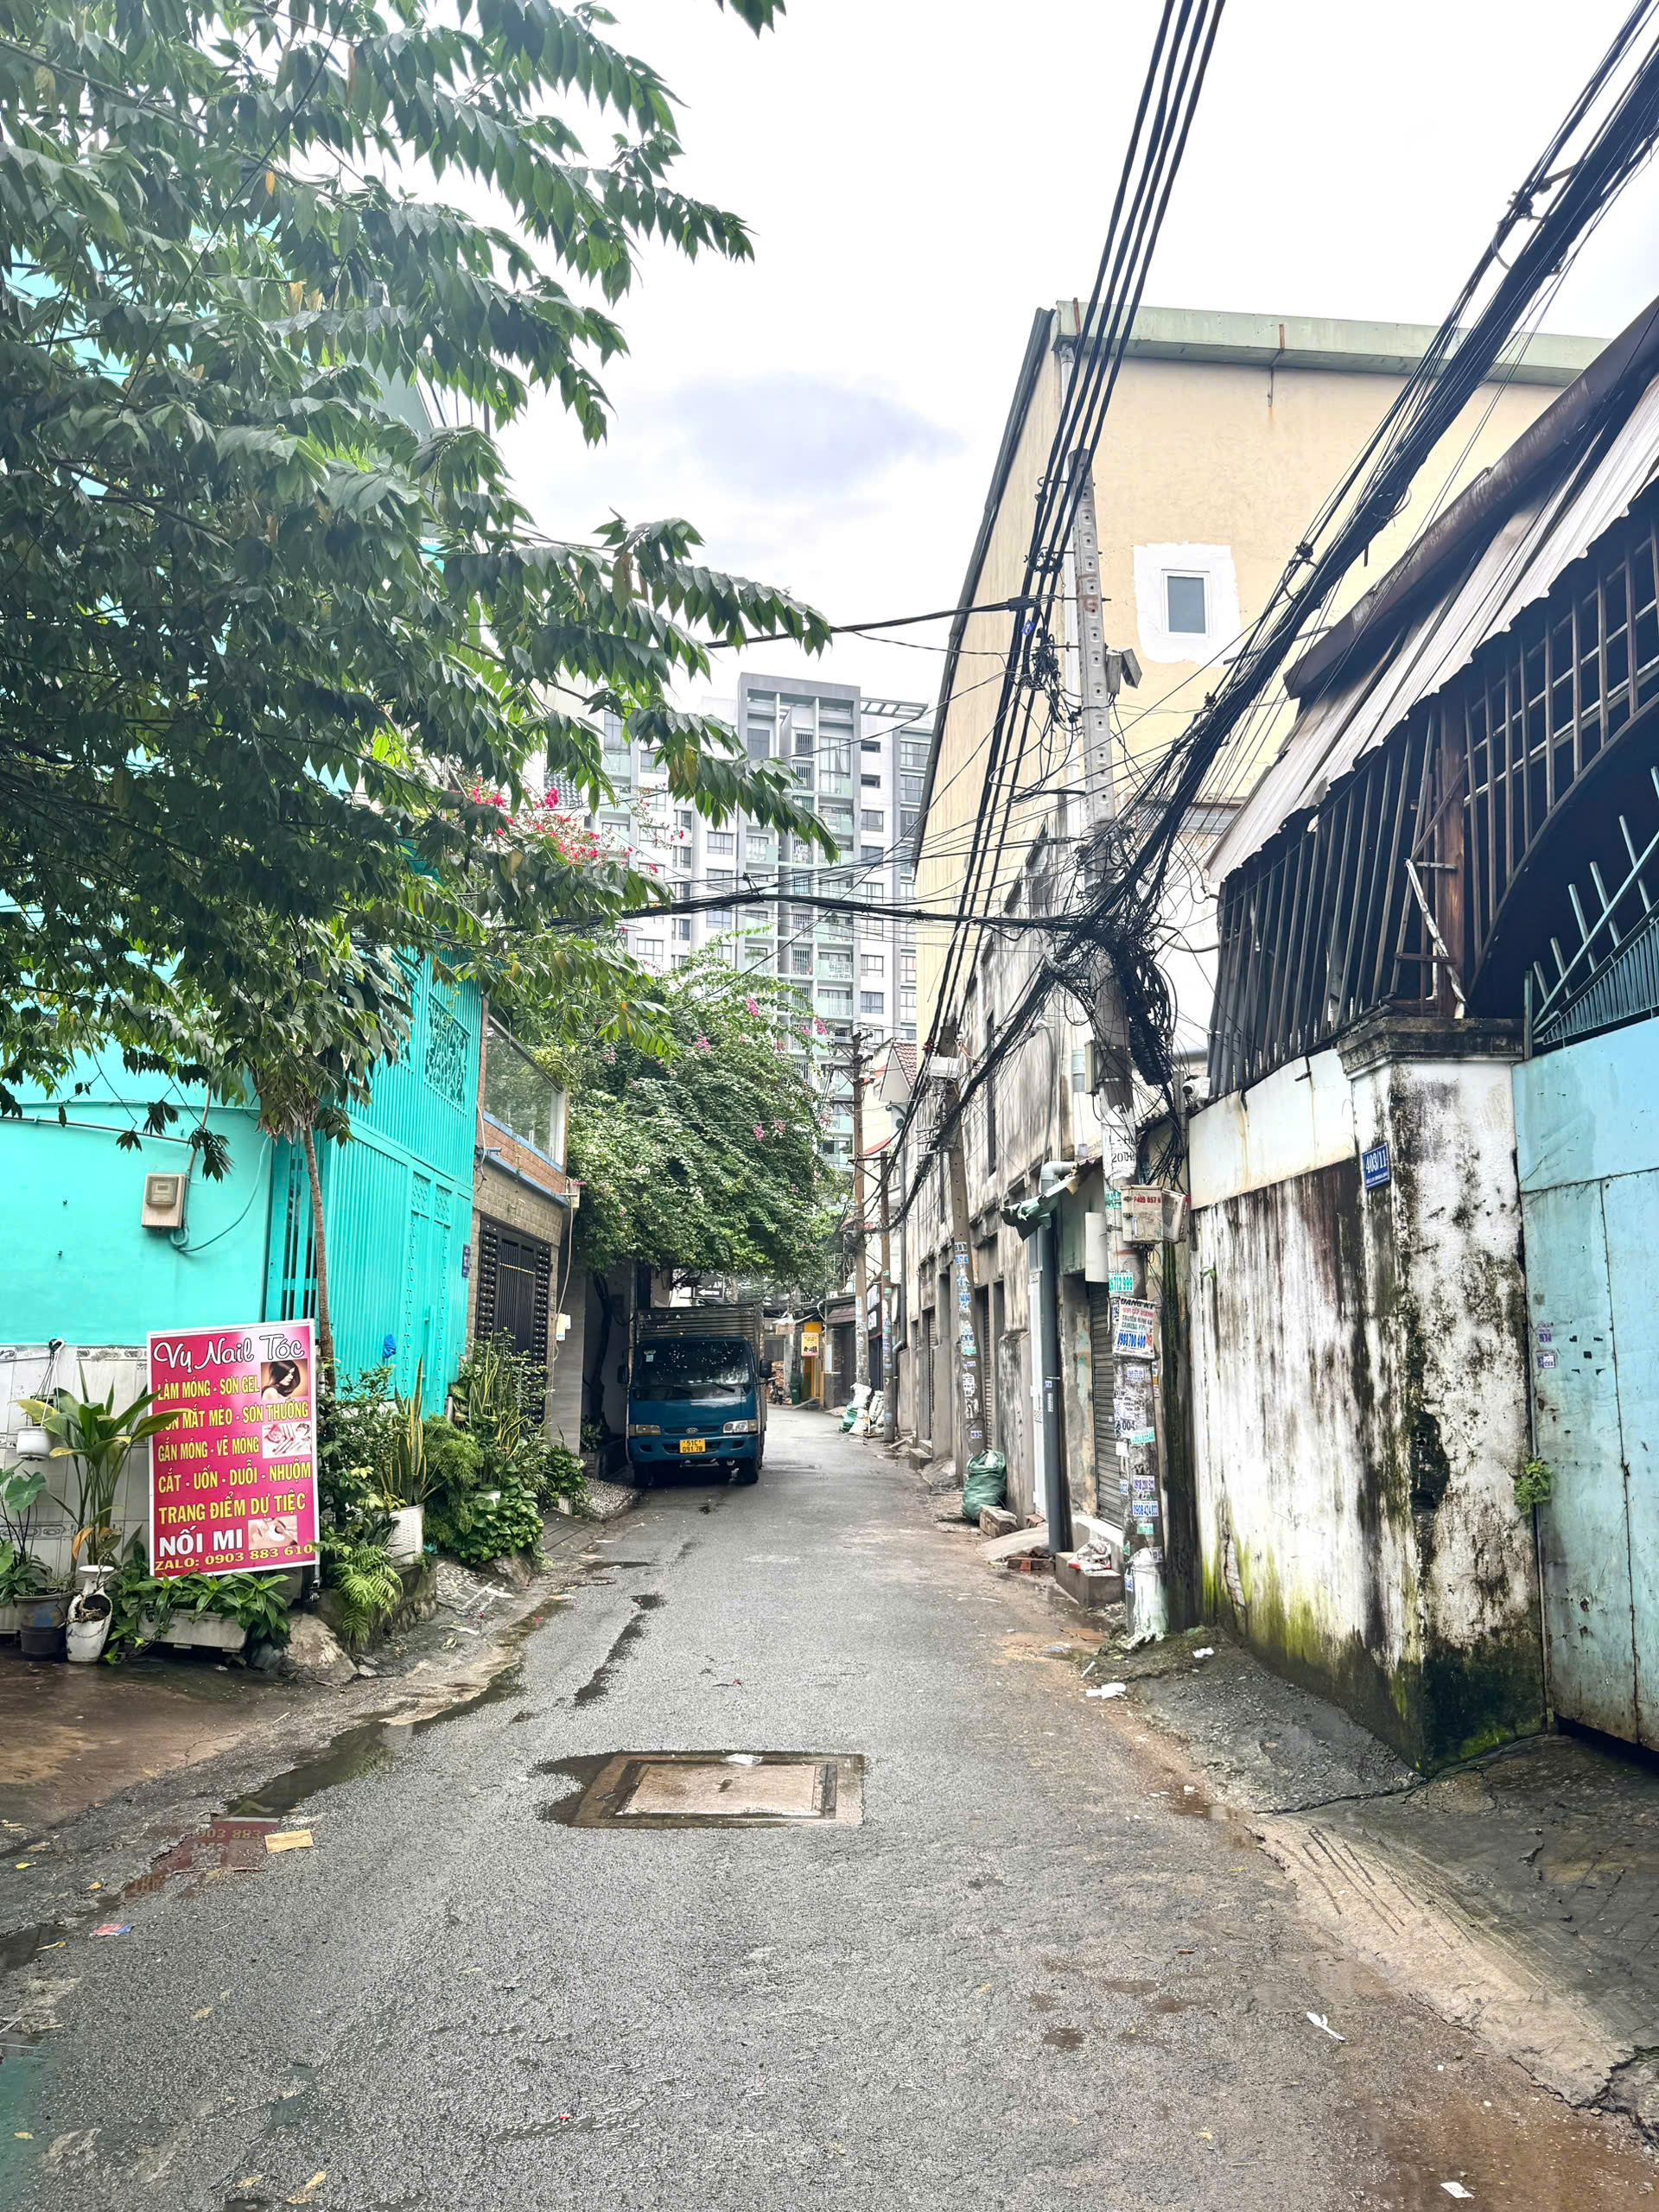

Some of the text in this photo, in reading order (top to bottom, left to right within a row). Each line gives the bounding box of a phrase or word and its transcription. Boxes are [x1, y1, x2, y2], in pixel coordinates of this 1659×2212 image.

[1365, 1150, 1387, 1174] 403/11
[153, 1333, 304, 1373] Vụ Nail Tóc
[157, 1375, 260, 1401] LÀM MÓNG SƠN GEL
[182, 1403, 205, 1428] MẮT
[209, 1408, 232, 1427] MÈO
[242, 1403, 263, 1423] SƠN
[158, 1432, 259, 1462] GẮN MÓNG VẼ MÓNG
[158, 1459, 311, 1493] CẮT UỐN DUỖI NHUỘM
[158, 1490, 305, 1525] TRANG ĐIỂM DỰ TIỆC
[159, 1525, 243, 1557] NỐI MI
[155, 1543, 313, 1571] ZALO: 0903 883 610
